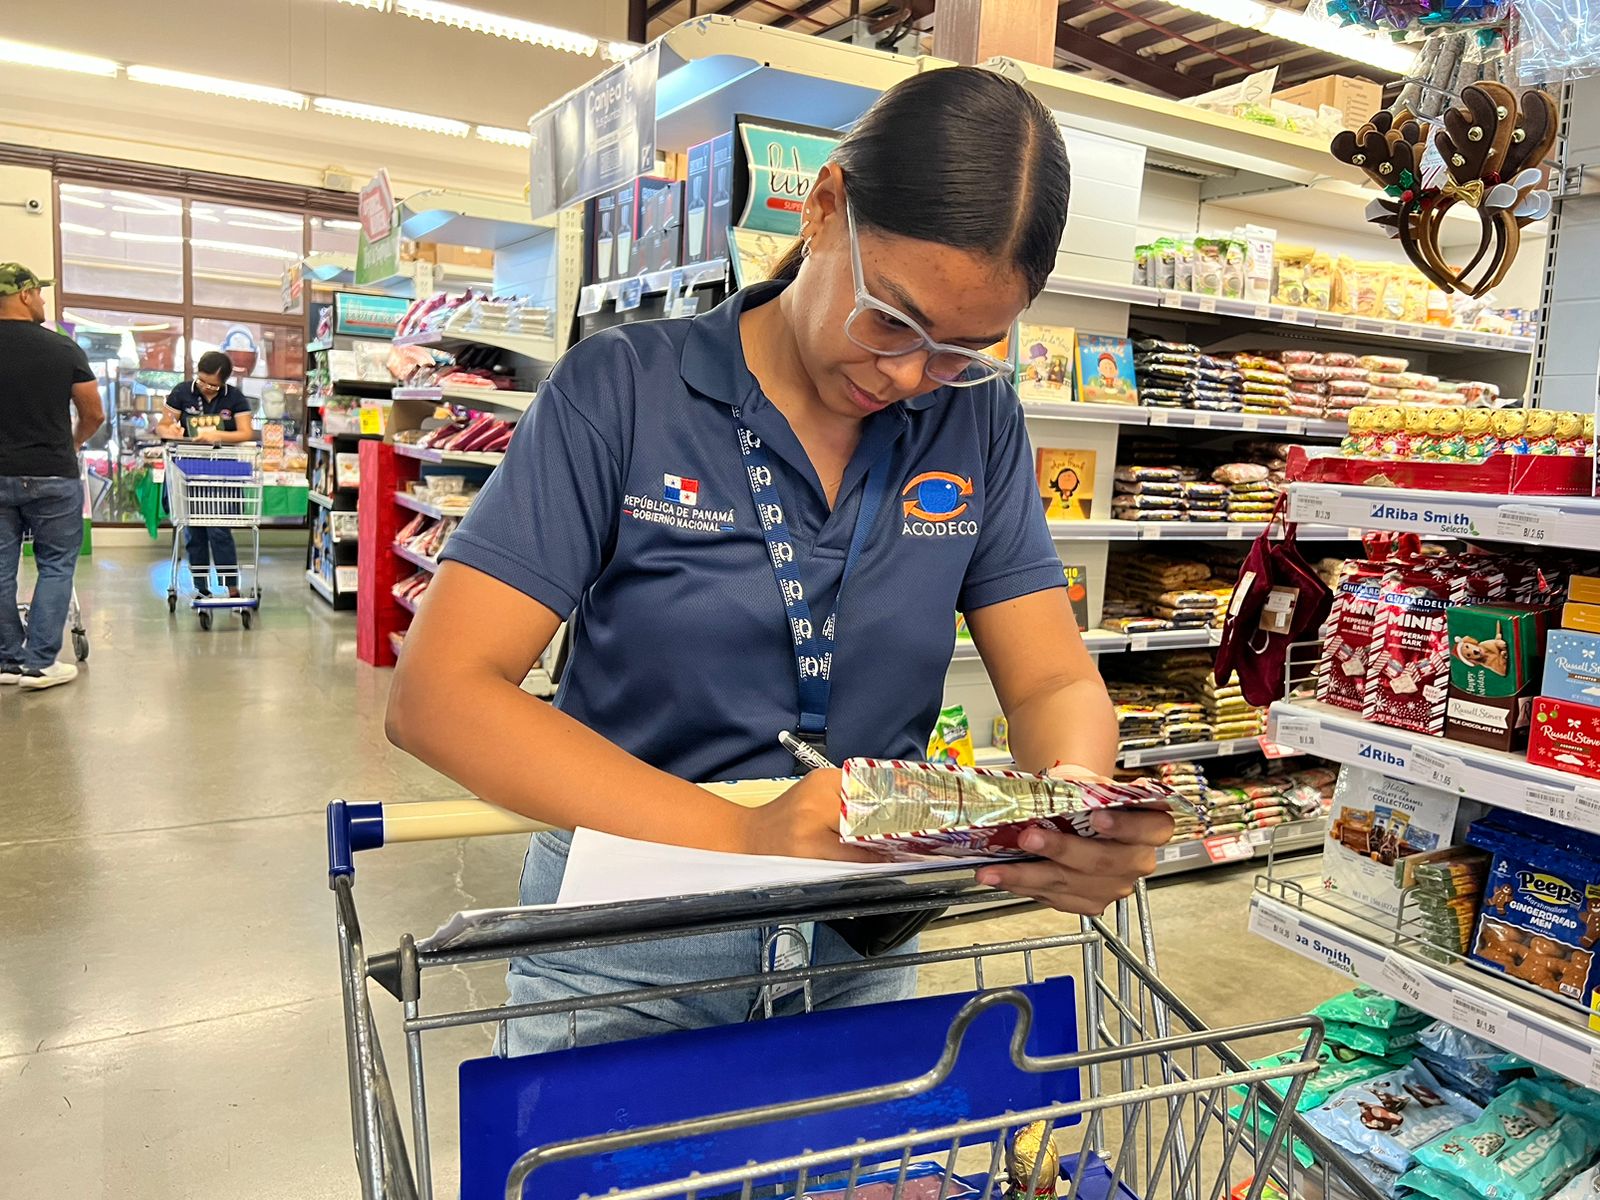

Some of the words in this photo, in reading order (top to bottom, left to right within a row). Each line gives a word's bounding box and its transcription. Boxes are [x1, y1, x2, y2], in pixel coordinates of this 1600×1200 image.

[767, 142, 810, 197] lib
[624, 495, 674, 515] REPÚBLICA
[676, 506, 690, 518] DE
[692, 508, 735, 523] PANAMÁ
[1385, 507, 1418, 521] Riba
[1423, 510, 1469, 526] Smith
[632, 508, 679, 526] GOBIERNO
[676, 519, 721, 532] NACIONAL
[902, 520, 978, 537] ACODECO
[1440, 524, 1469, 535] Selecto
[1388, 611, 1445, 632] MINIS
[1401, 638, 1422, 647] BARK
[1555, 656, 1589, 672] Russell
[1588, 662, 1600, 674] St
[1452, 702, 1478, 717] Russell
[1461, 721, 1492, 732] CHOCOLATE
[1492, 727, 1504, 735] BAR
[1540, 724, 1575, 742] Russell
[1574, 732, 1600, 747] Stove
[1373, 748, 1405, 767] Riba
[1372, 793, 1416, 812] COLLECTION
[1515, 870, 1584, 906] Peeps
[1509, 900, 1577, 929] GINGERBREAD
[1530, 916, 1553, 930] MEN
[1313, 940, 1351, 965] Smith
[1327, 957, 1350, 973] Selecto
